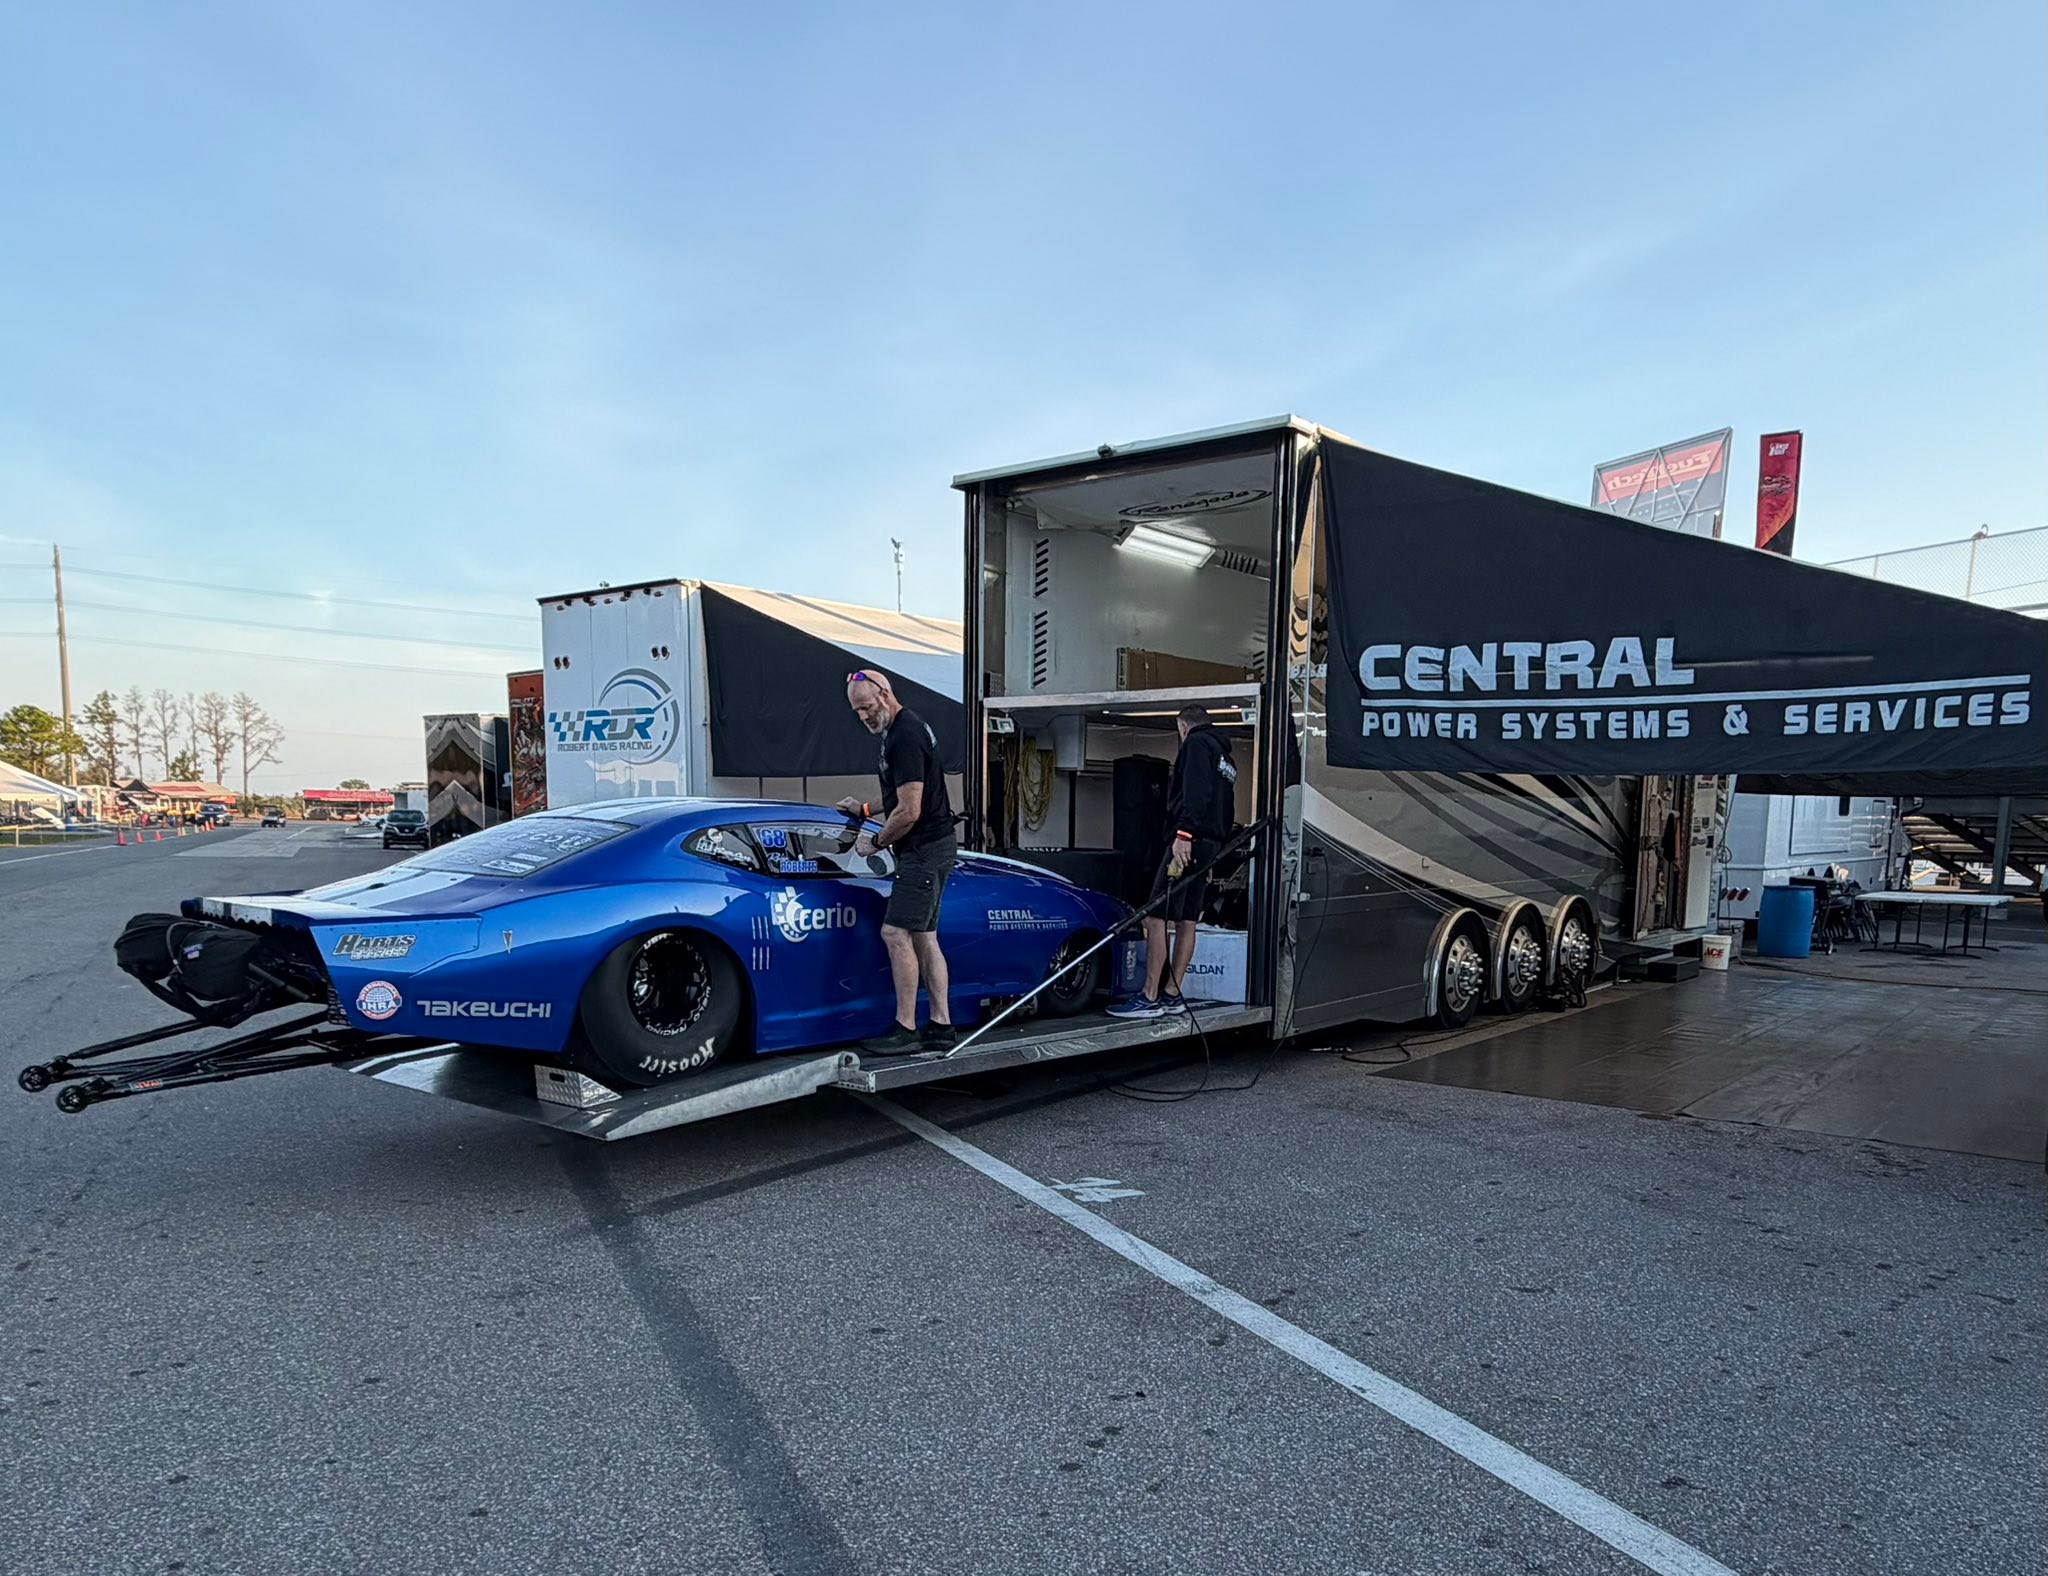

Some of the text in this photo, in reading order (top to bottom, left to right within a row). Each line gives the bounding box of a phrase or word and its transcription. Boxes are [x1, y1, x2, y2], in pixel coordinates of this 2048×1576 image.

[1134, 490, 1250, 515] Renegade
[1359, 637, 1695, 692] CENTRAL
[1362, 691, 2031, 740] POWER SYSTEMS & SERVICES
[557, 741, 652, 752] ROBERT DAVIS RACING
[760, 828, 787, 848] 68
[780, 860, 818, 873] ROBERTS
[800, 902, 857, 931] cerio
[987, 909, 1034, 920] CENTRAL
[1704, 947, 1725, 958] ACE
